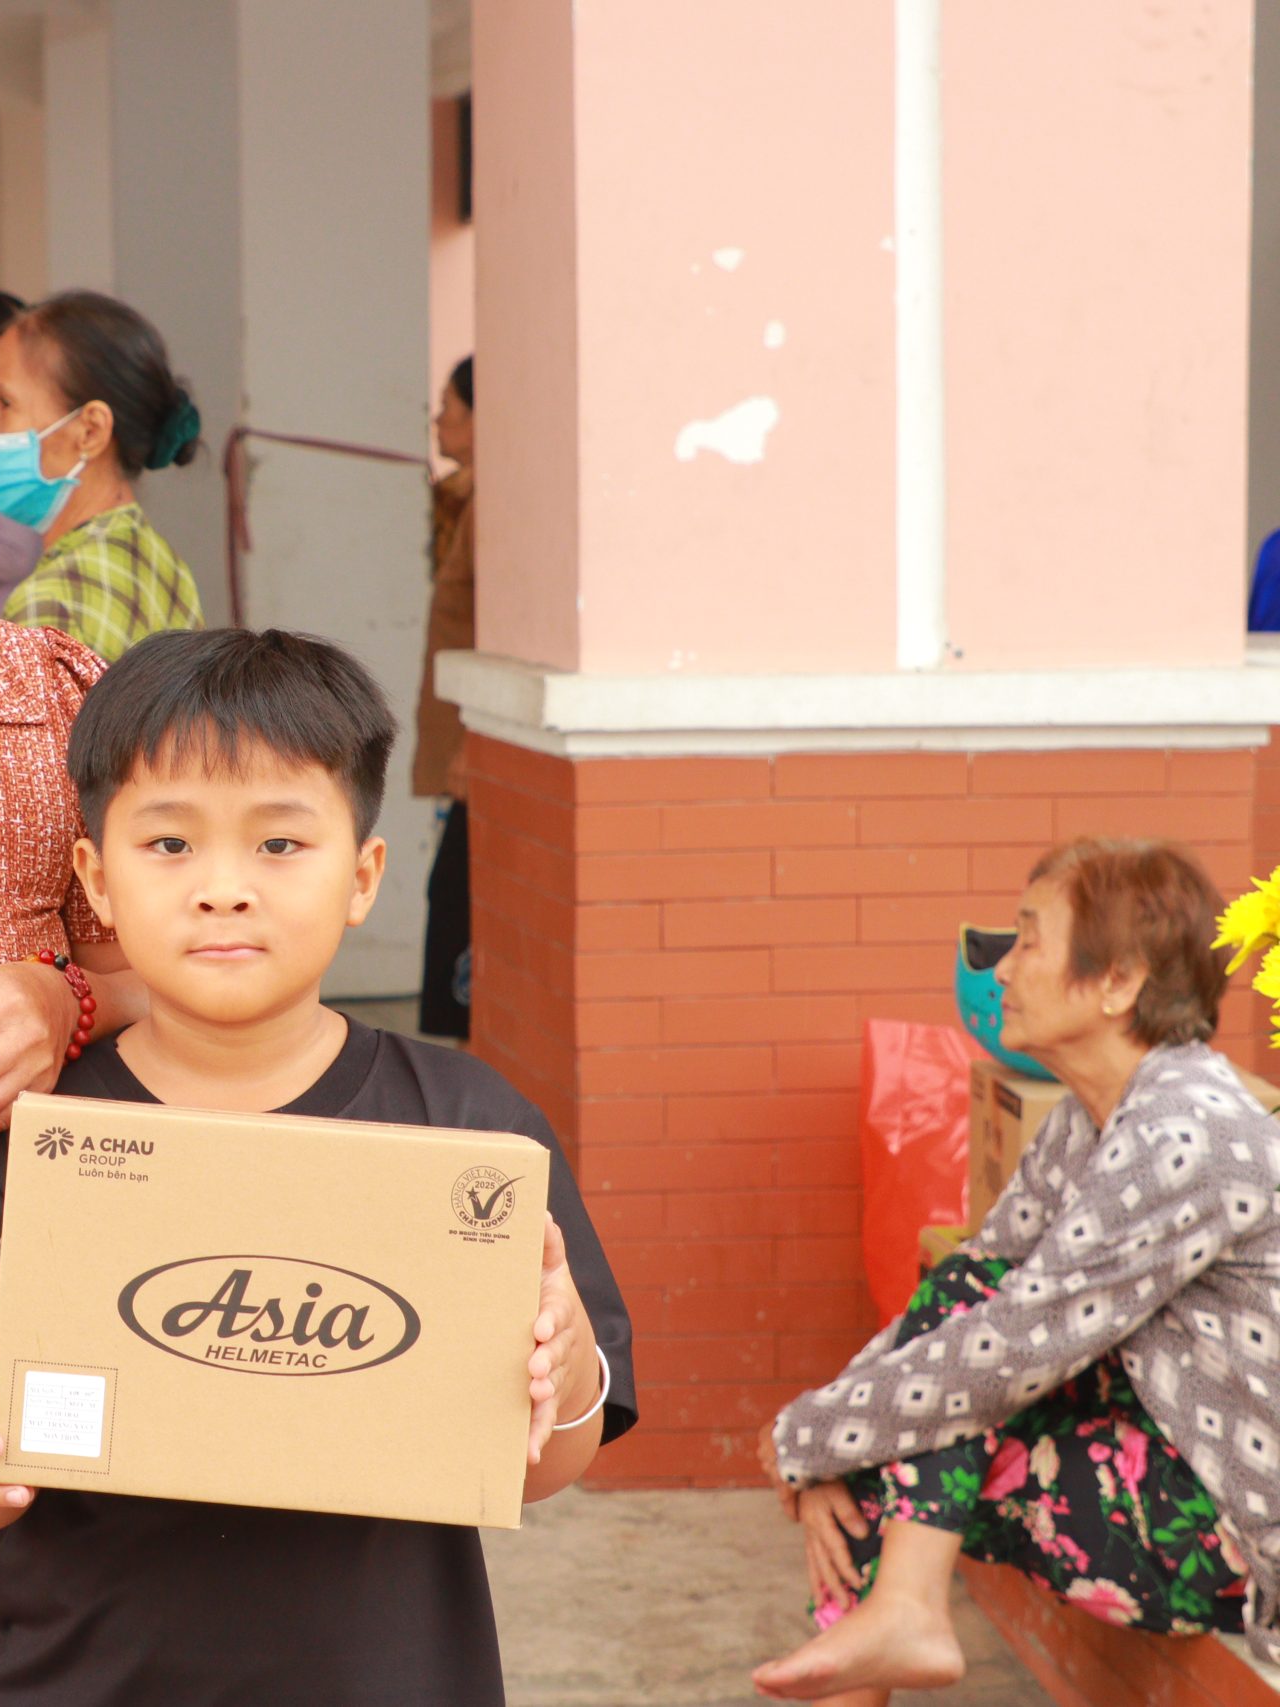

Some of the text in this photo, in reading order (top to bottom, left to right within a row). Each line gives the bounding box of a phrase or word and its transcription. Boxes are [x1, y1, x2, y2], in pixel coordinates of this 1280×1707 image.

[80, 1136, 154, 1156] A CHAU
[79, 1153, 126, 1167] GROUP
[78, 1167, 149, 1183] Luôn bên bạn
[484, 1169, 505, 1184] NAM
[475, 1181, 495, 1190] 2025
[161, 1269, 375, 1351] Asia
[205, 1344, 328, 1368] HELMETAC
